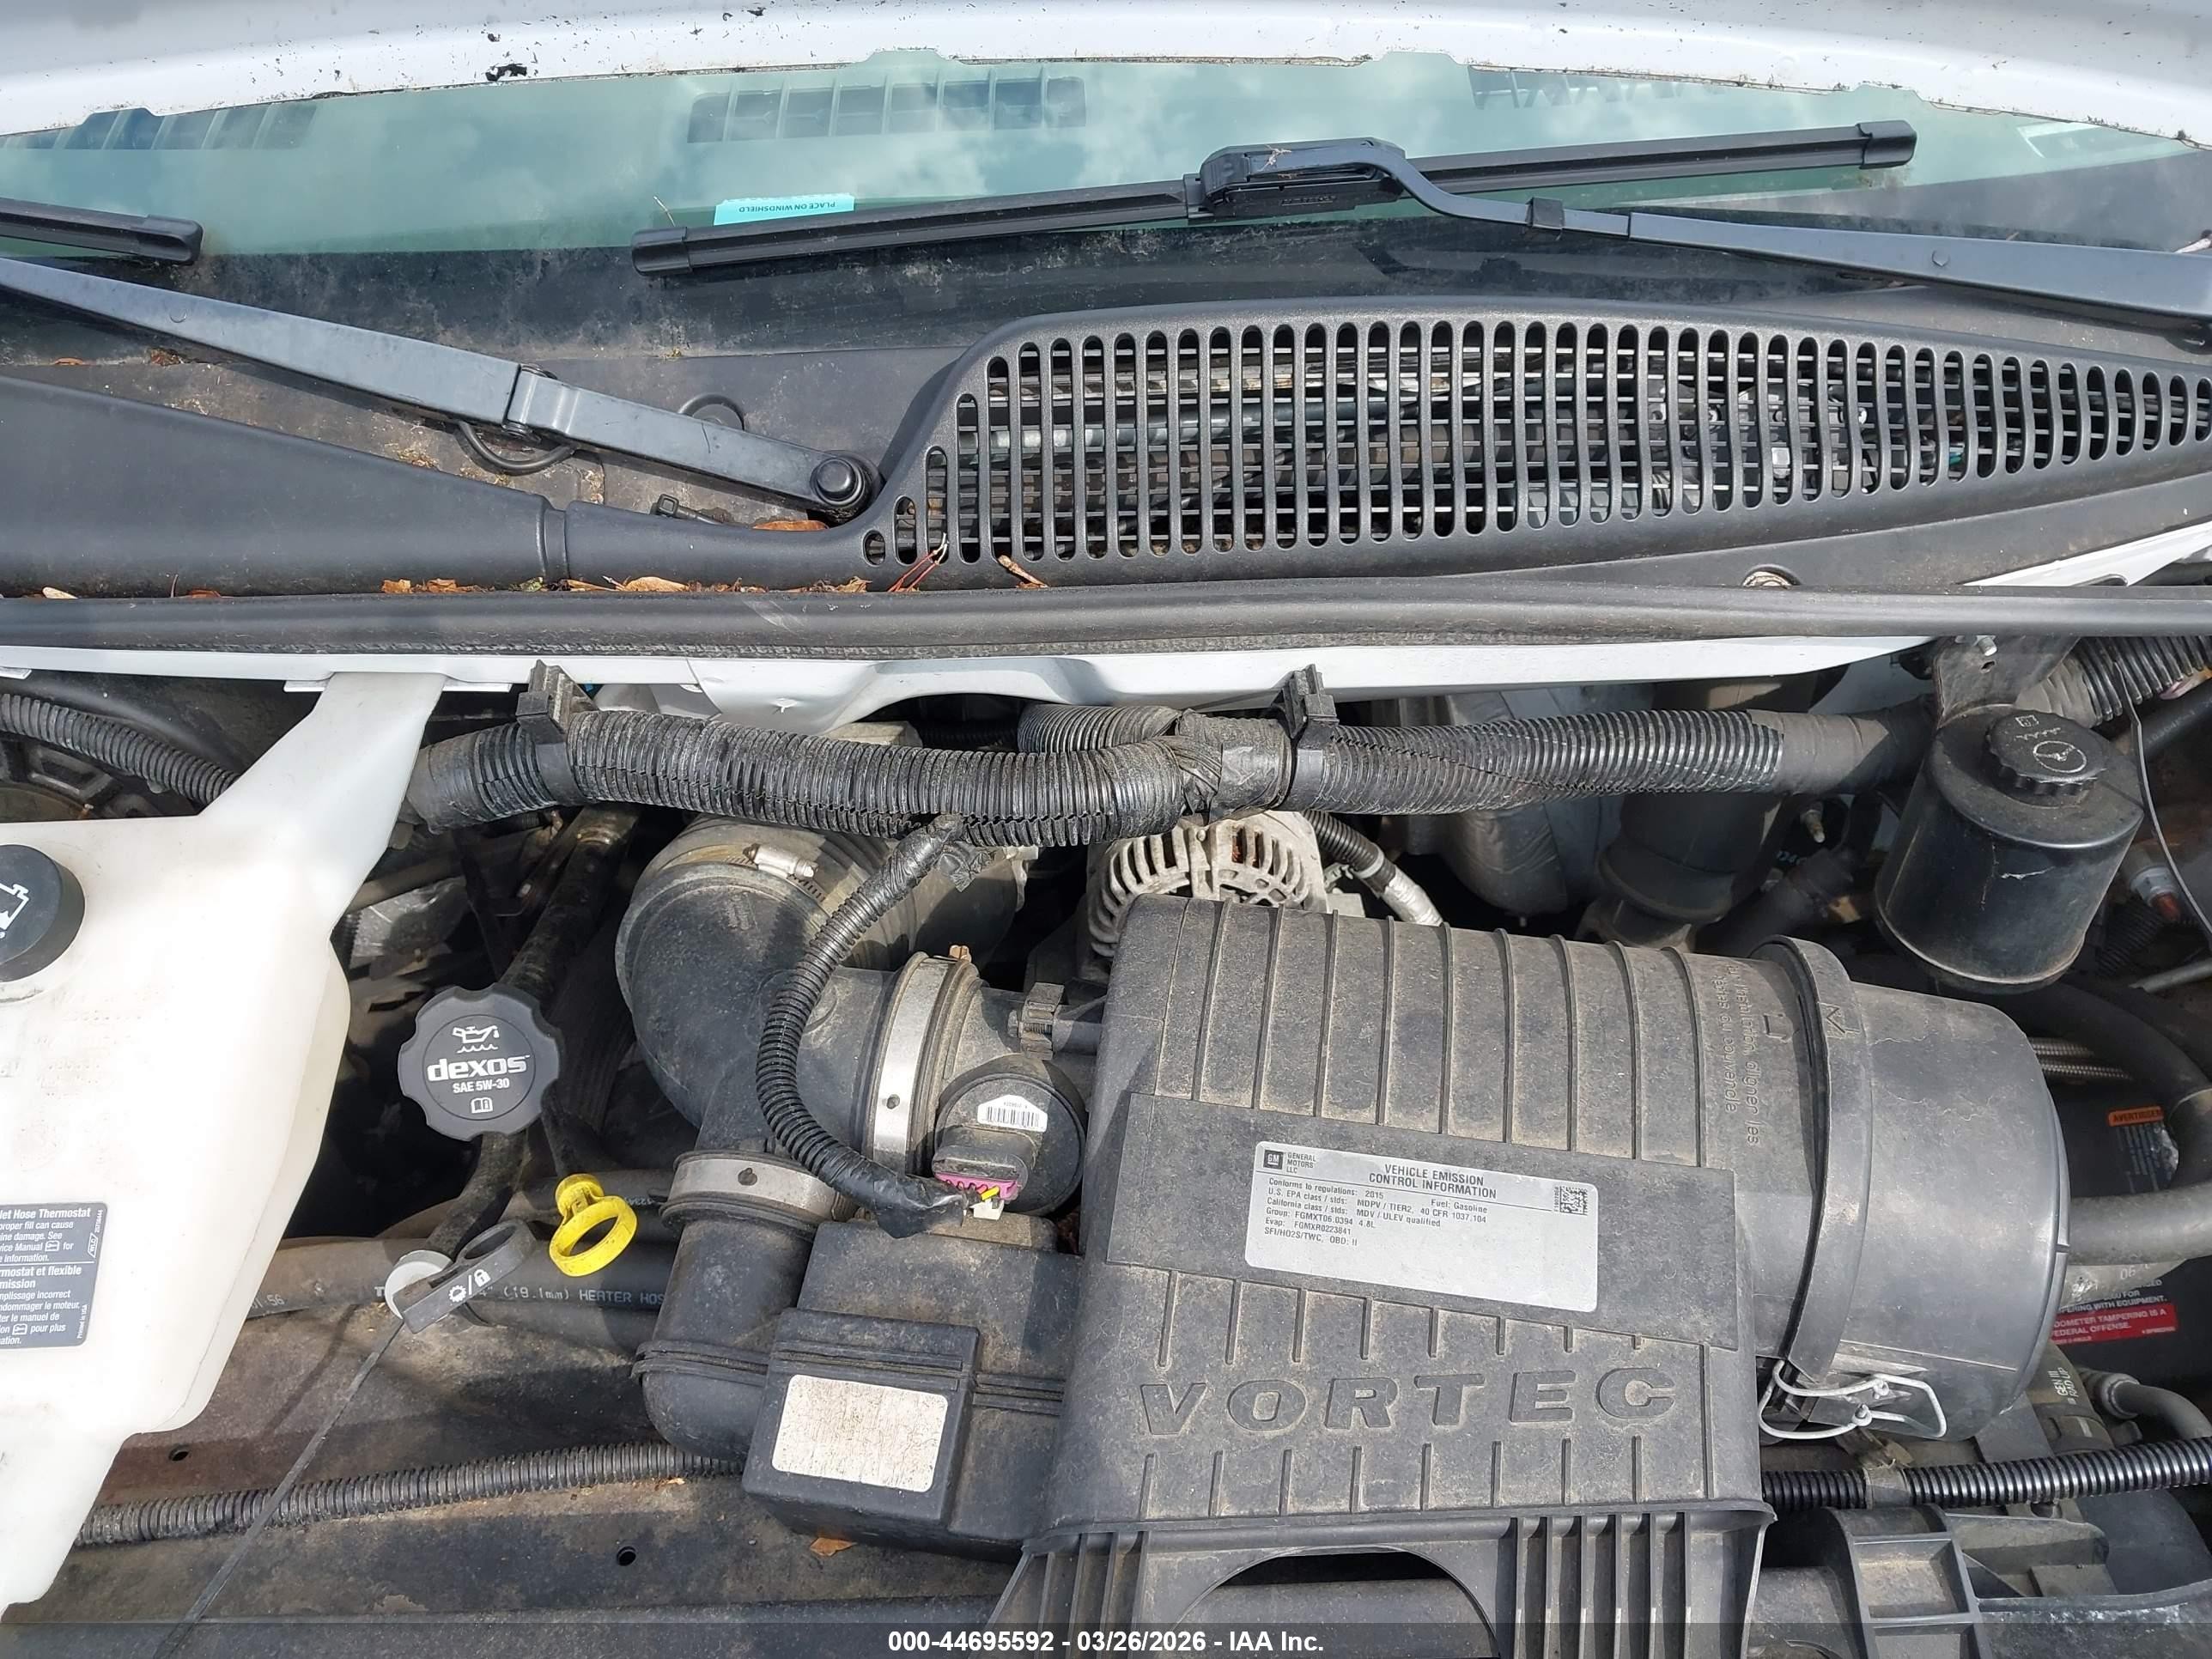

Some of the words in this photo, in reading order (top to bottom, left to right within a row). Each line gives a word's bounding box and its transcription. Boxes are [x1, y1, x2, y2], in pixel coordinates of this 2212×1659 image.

[427, 1054, 527, 1081] dexos
[453, 1081, 474, 1094] SAE
[476, 1078, 510, 1091] 5W-30
[1745, 1120, 1761, 1146] les
[1267, 1153, 1279, 1164] GM
[1288, 1152, 1316, 1162] GENERAL
[1287, 1160, 1314, 1169] MOTORS
[1385, 1164, 1428, 1178] VEHICLE
[1432, 1171, 1484, 1186] EMISSION
[1269, 1177, 1303, 1189] Conforms
[1315, 1186, 1358, 1196] regulations:
[1365, 1190, 1383, 1200] 2015
[1370, 1173, 1418, 1188] CONTROL
[1422, 1180, 1497, 1199] INFORMATION
[1267, 1197, 1301, 1208] California
[1304, 1203, 1322, 1212] class
[1357, 1209, 1375, 1218] MDV
[1383, 1212, 1403, 1222] ULEV
[1407, 1217, 1441, 1227] qualified
[1268, 1188, 1283, 1196] U.S.
[1287, 1190, 1301, 1199] EPA
[1304, 1193, 1322, 1203] class
[1358, 1199, 1381, 1209] MDPV
[1452, 1212, 1486, 1223] 1037.104
[1431, 1199, 1450, 1208] Fuel:
[1454, 1202, 1487, 1213] Gasoline
[13, 1209, 36, 1219] Hose
[39, 1207, 91, 1218] Thermostat
[1266, 1207, 1290, 1218] Group:
[24, 1221, 34, 1230] fill
[1265, 1217, 1285, 1227] Evap:
[14, 1233, 46, 1243] damage.
[1329, 1236, 1349, 1245] OBD:
[15, 1243, 43, 1251] Manual
[63, 1242, 74, 1250] for
[36, 1267, 46, 1276] et
[48, 1265, 82, 1276] flexible
[37, 1290, 70, 1299] incorrect
[580, 1289, 631, 1303] HEATER
[53, 1301, 80, 1310] moteur.
[2095, 1301, 2115, 1310] WITH
[2117, 1295, 2167, 1306] EQUIPMENT.
[21, 1313, 48, 1322] manuel
[50, 1312, 60, 1321] de
[2098, 1310, 2148, 1323] TAMPERING
[2149, 1309, 2158, 1317] IS
[30, 1324, 48, 1334] pour
[49, 1323, 66, 1334] plus
[2051, 1379, 2069, 1396] GEN
[2064, 1380, 2079, 1397] RAD
[1139, 1368, 1676, 1435] VORTEC
